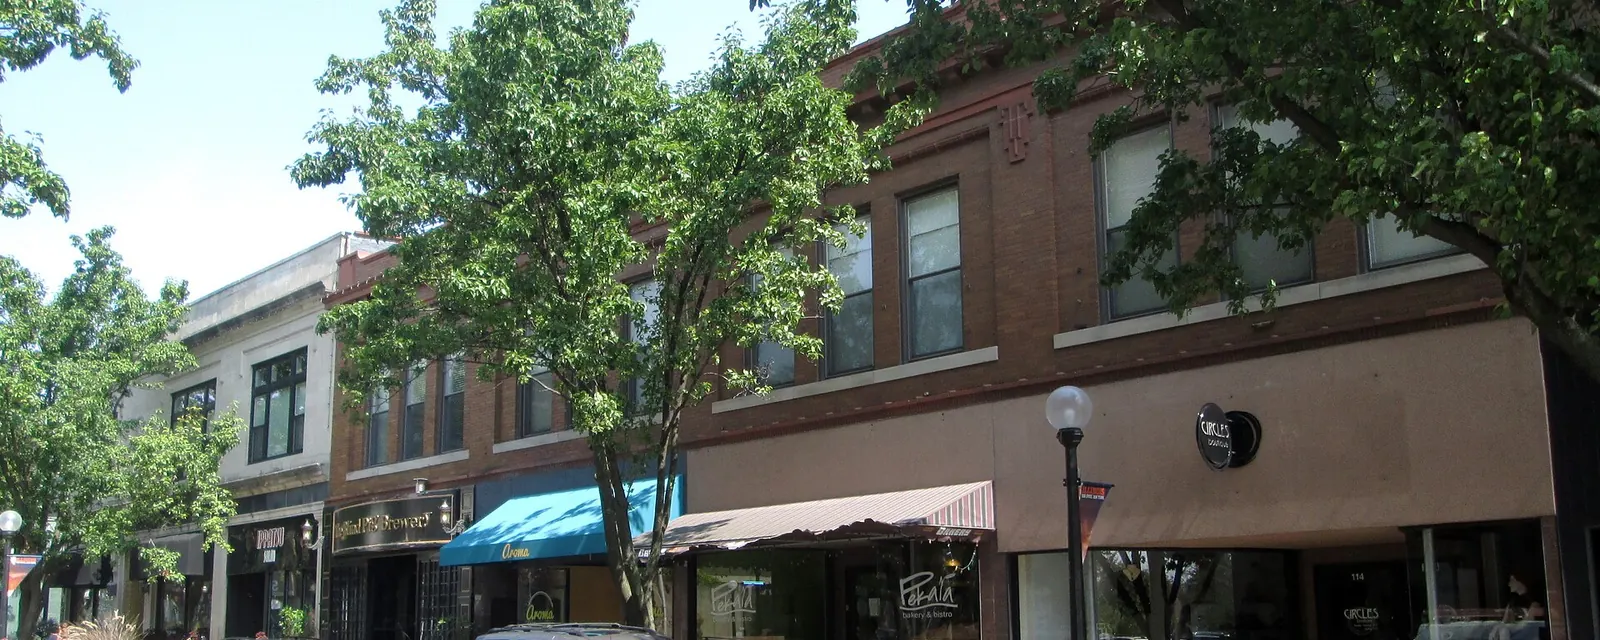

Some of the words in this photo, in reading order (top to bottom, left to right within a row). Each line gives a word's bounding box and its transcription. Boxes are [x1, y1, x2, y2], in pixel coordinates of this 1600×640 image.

[1201, 421, 1229, 438] CIRCLES
[502, 543, 530, 559] Aroma
[1351, 573, 1365, 581] 114
[903, 612, 925, 620] bakery
[933, 610, 953, 618] bistro
[1343, 608, 1379, 620] CIRCLES
